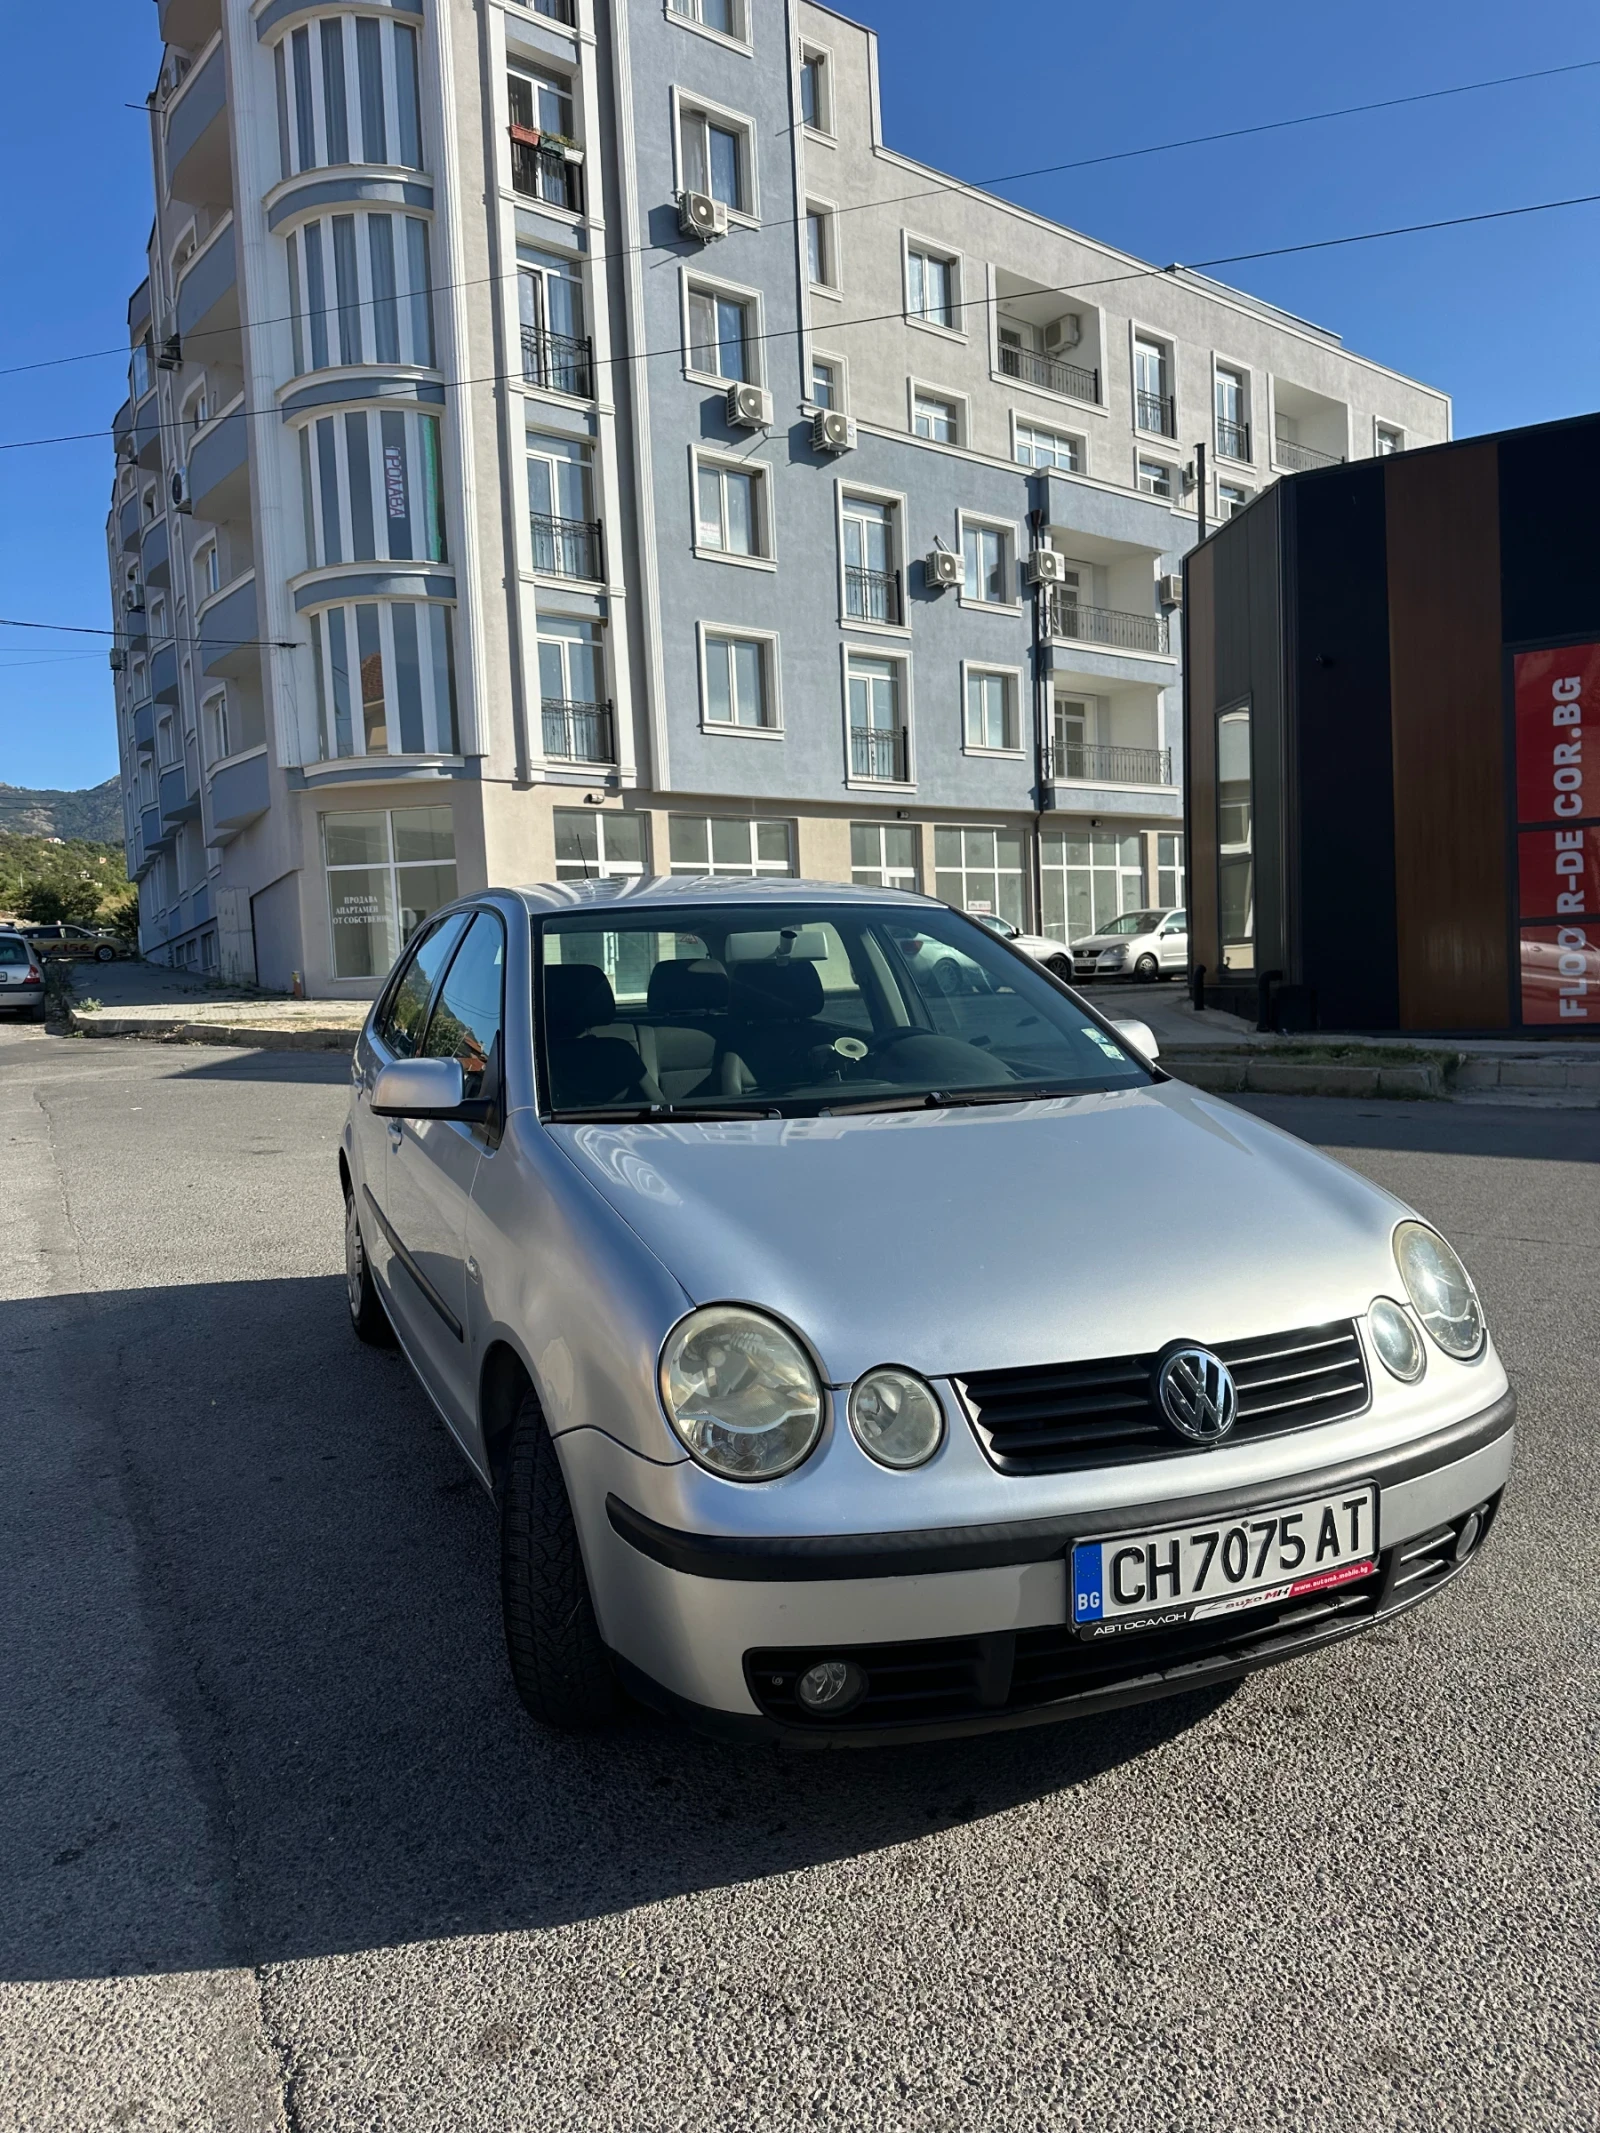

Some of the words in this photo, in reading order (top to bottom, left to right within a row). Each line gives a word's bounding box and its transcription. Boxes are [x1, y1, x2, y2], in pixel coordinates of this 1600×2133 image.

[385, 446, 405, 518] ПРОДАВА
[344, 896, 378, 904] ПРОДАВА
[51, 943, 90, 952] 6156
[1190, 1512, 1306, 1592] 7075
[1294, 1566, 1368, 1592] www.automk.mobile.bg
[1077, 1591, 1100, 1611] BG
[1093, 1611, 1187, 1636] АВТОСАЛОН
